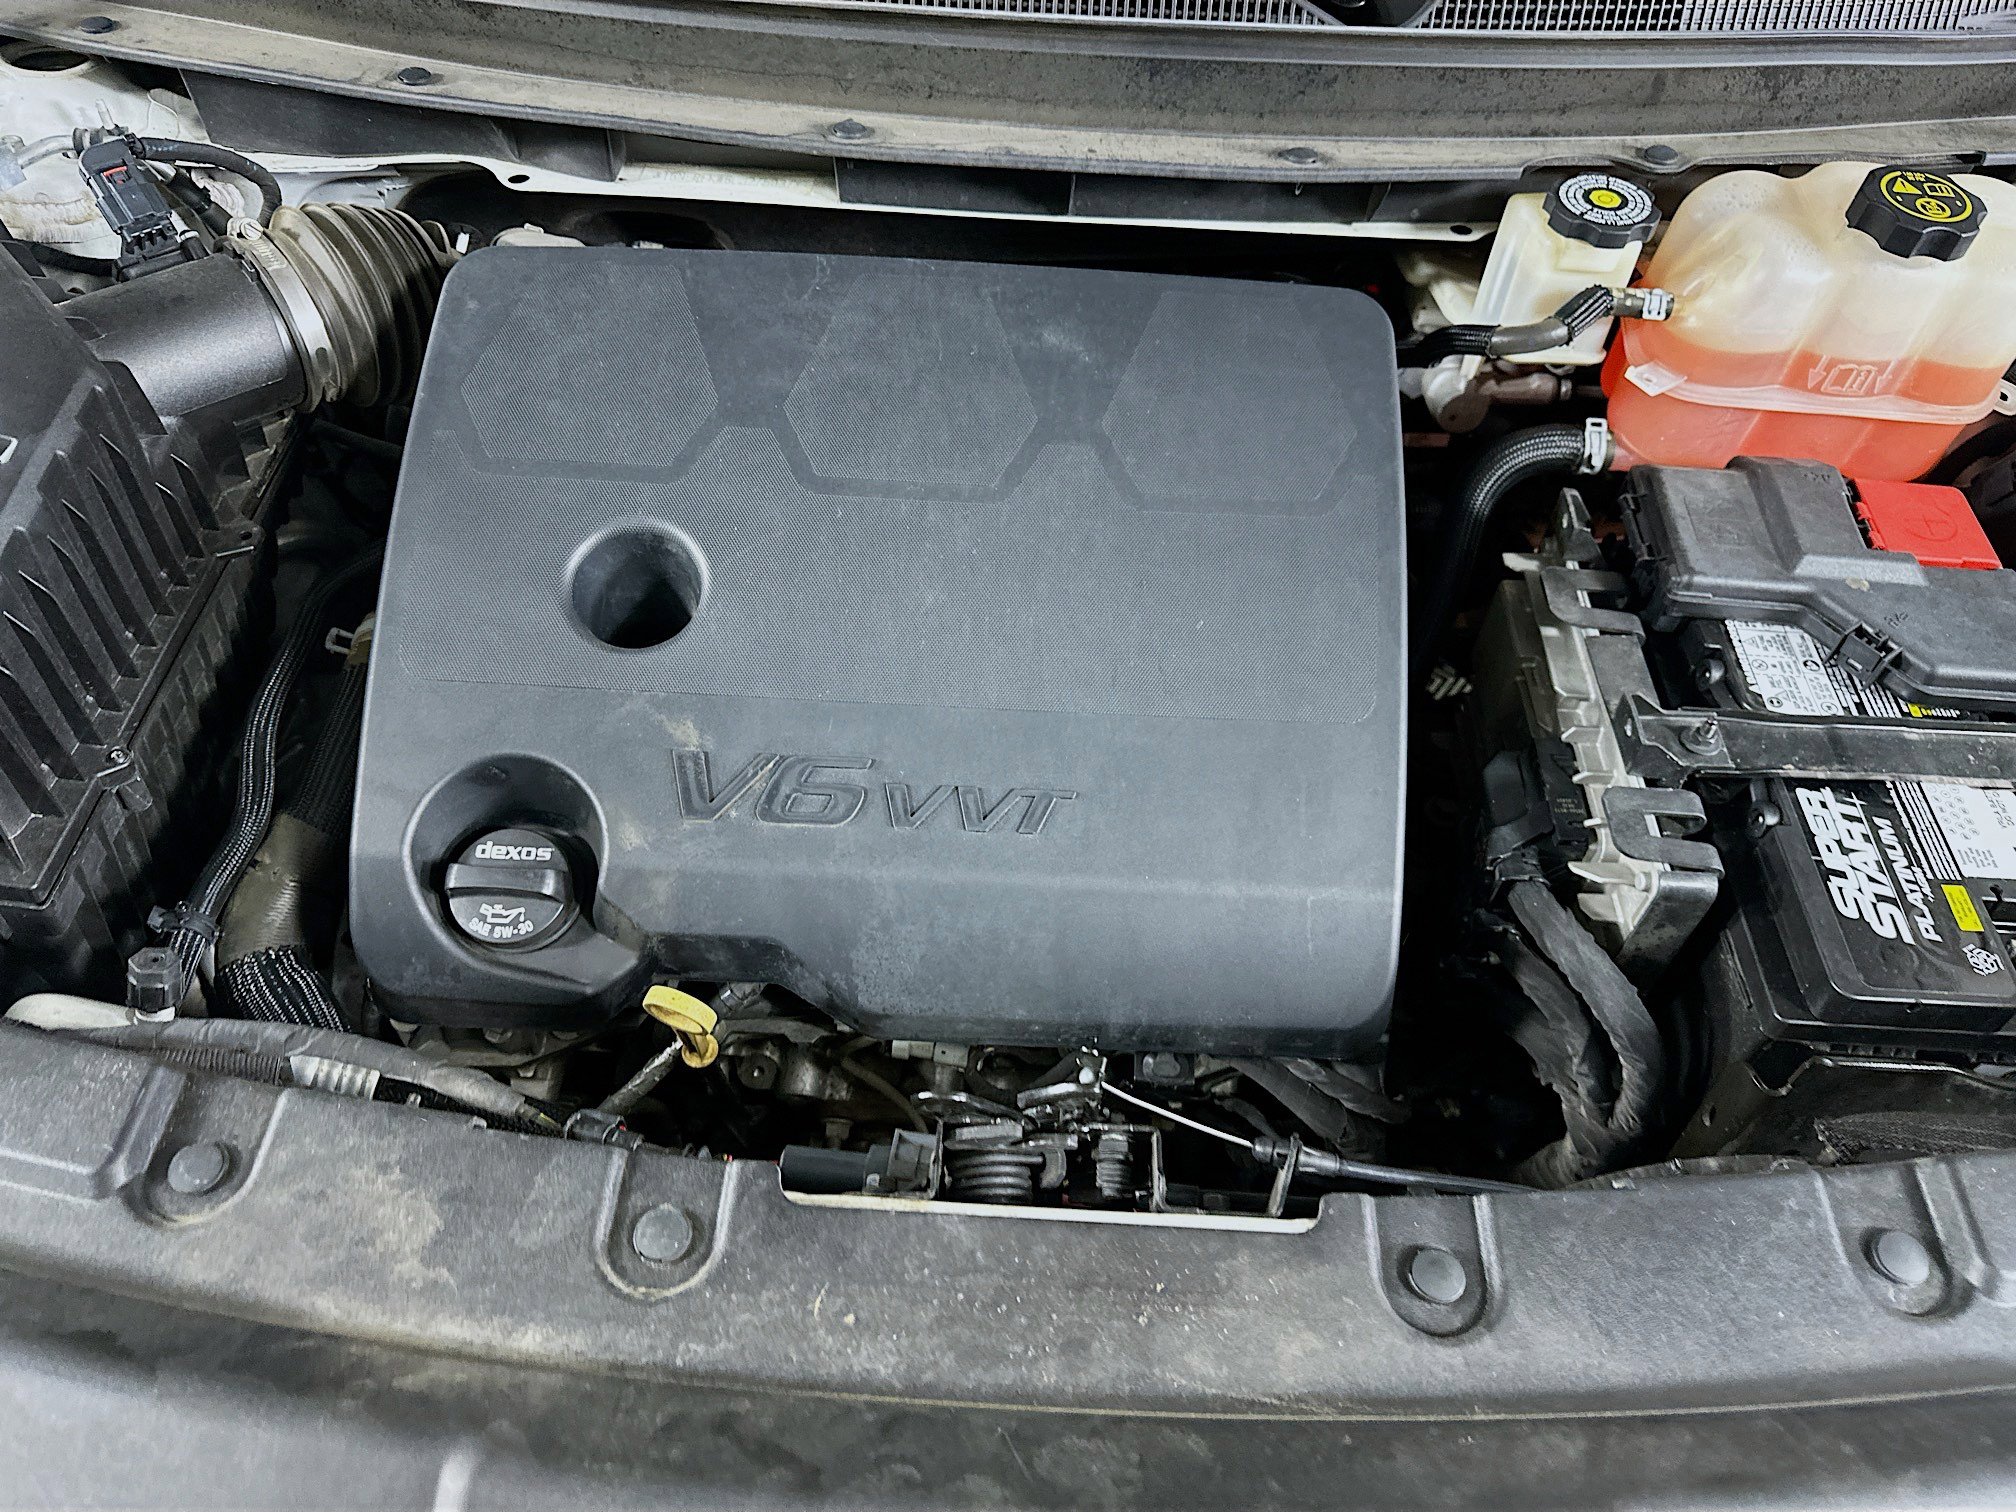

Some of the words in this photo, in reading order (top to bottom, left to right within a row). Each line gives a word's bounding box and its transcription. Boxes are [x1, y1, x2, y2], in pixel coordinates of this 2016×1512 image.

[673, 748, 876, 828] V6
[884, 782, 1077, 835] VVT
[475, 841, 553, 861] dexos
[1795, 787, 1870, 922] SUPER
[1820, 786, 1917, 945] START
[1872, 816, 1943, 942] PLATINUM
[468, 917, 492, 937] SAE
[493, 920, 534, 938] 5W-30
